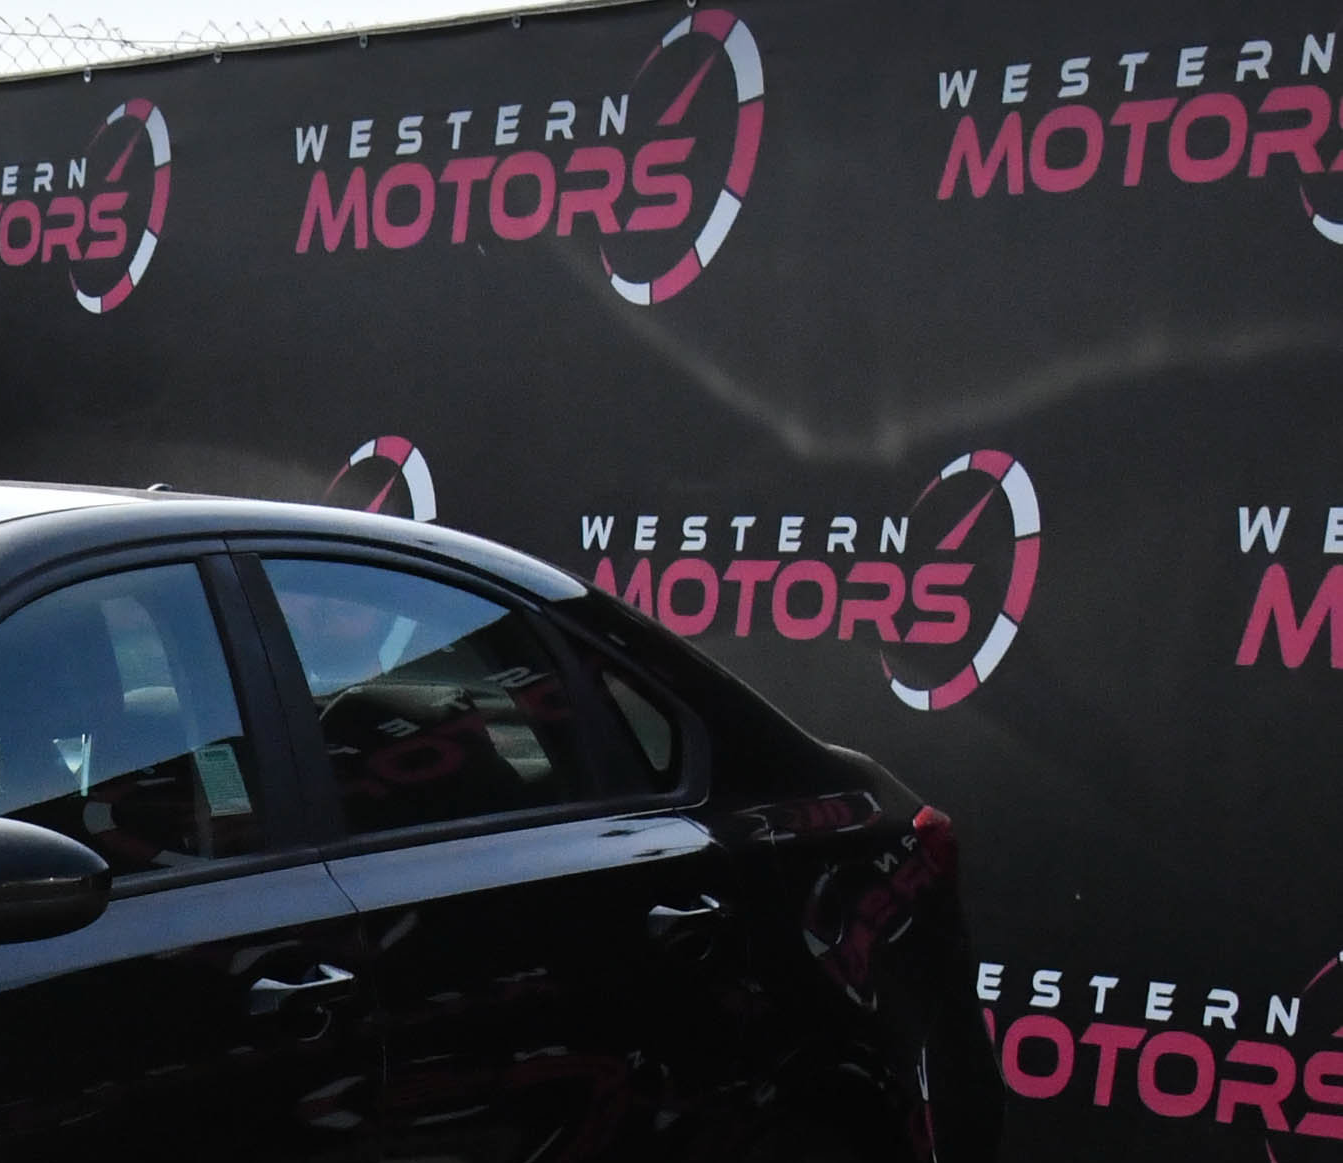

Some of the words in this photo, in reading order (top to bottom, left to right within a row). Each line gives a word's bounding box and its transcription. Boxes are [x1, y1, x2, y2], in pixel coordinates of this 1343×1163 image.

[938, 32, 1336, 110] WESTERN
[295, 94, 629, 165] WESTERN
[937, 85, 1343, 201] MOTOR
[294, 137, 697, 254] MOTORS
[581, 515, 909, 554] WESTERN
[594, 557, 976, 645] MOTORS
[983, 1008, 1343, 1141] OTORS
